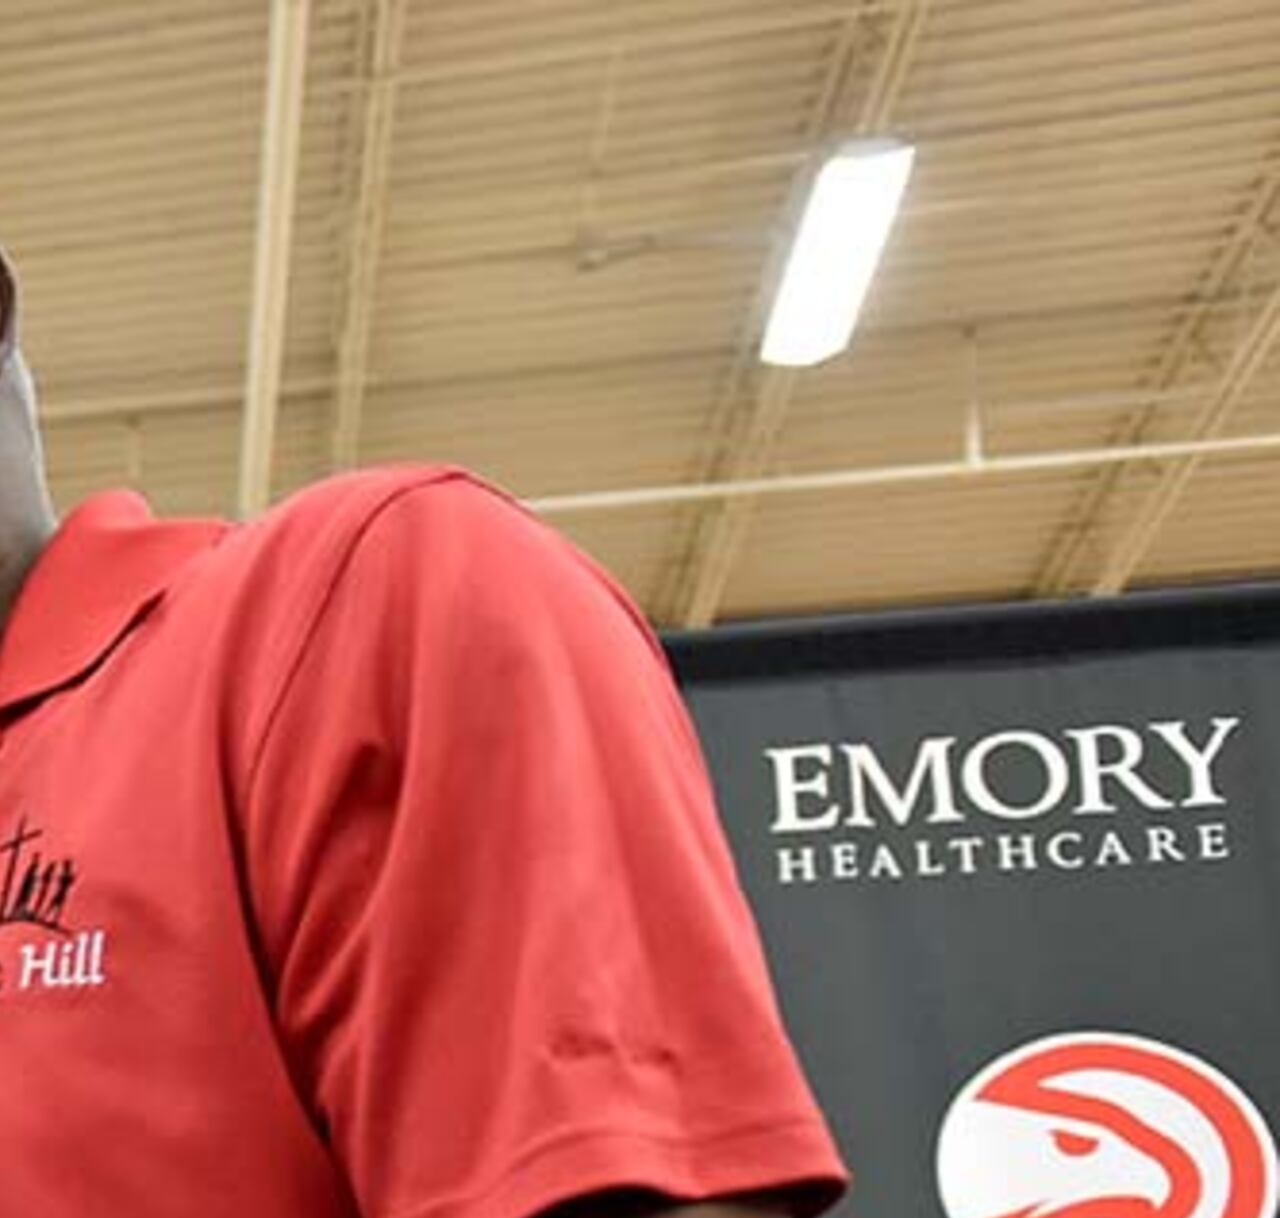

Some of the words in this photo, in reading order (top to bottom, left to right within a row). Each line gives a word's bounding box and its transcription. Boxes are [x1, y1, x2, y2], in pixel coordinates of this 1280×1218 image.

[764, 717, 1239, 832] EMORY
[777, 823, 1230, 883] HEALTHCARE
[18, 930, 105, 989] Hill
